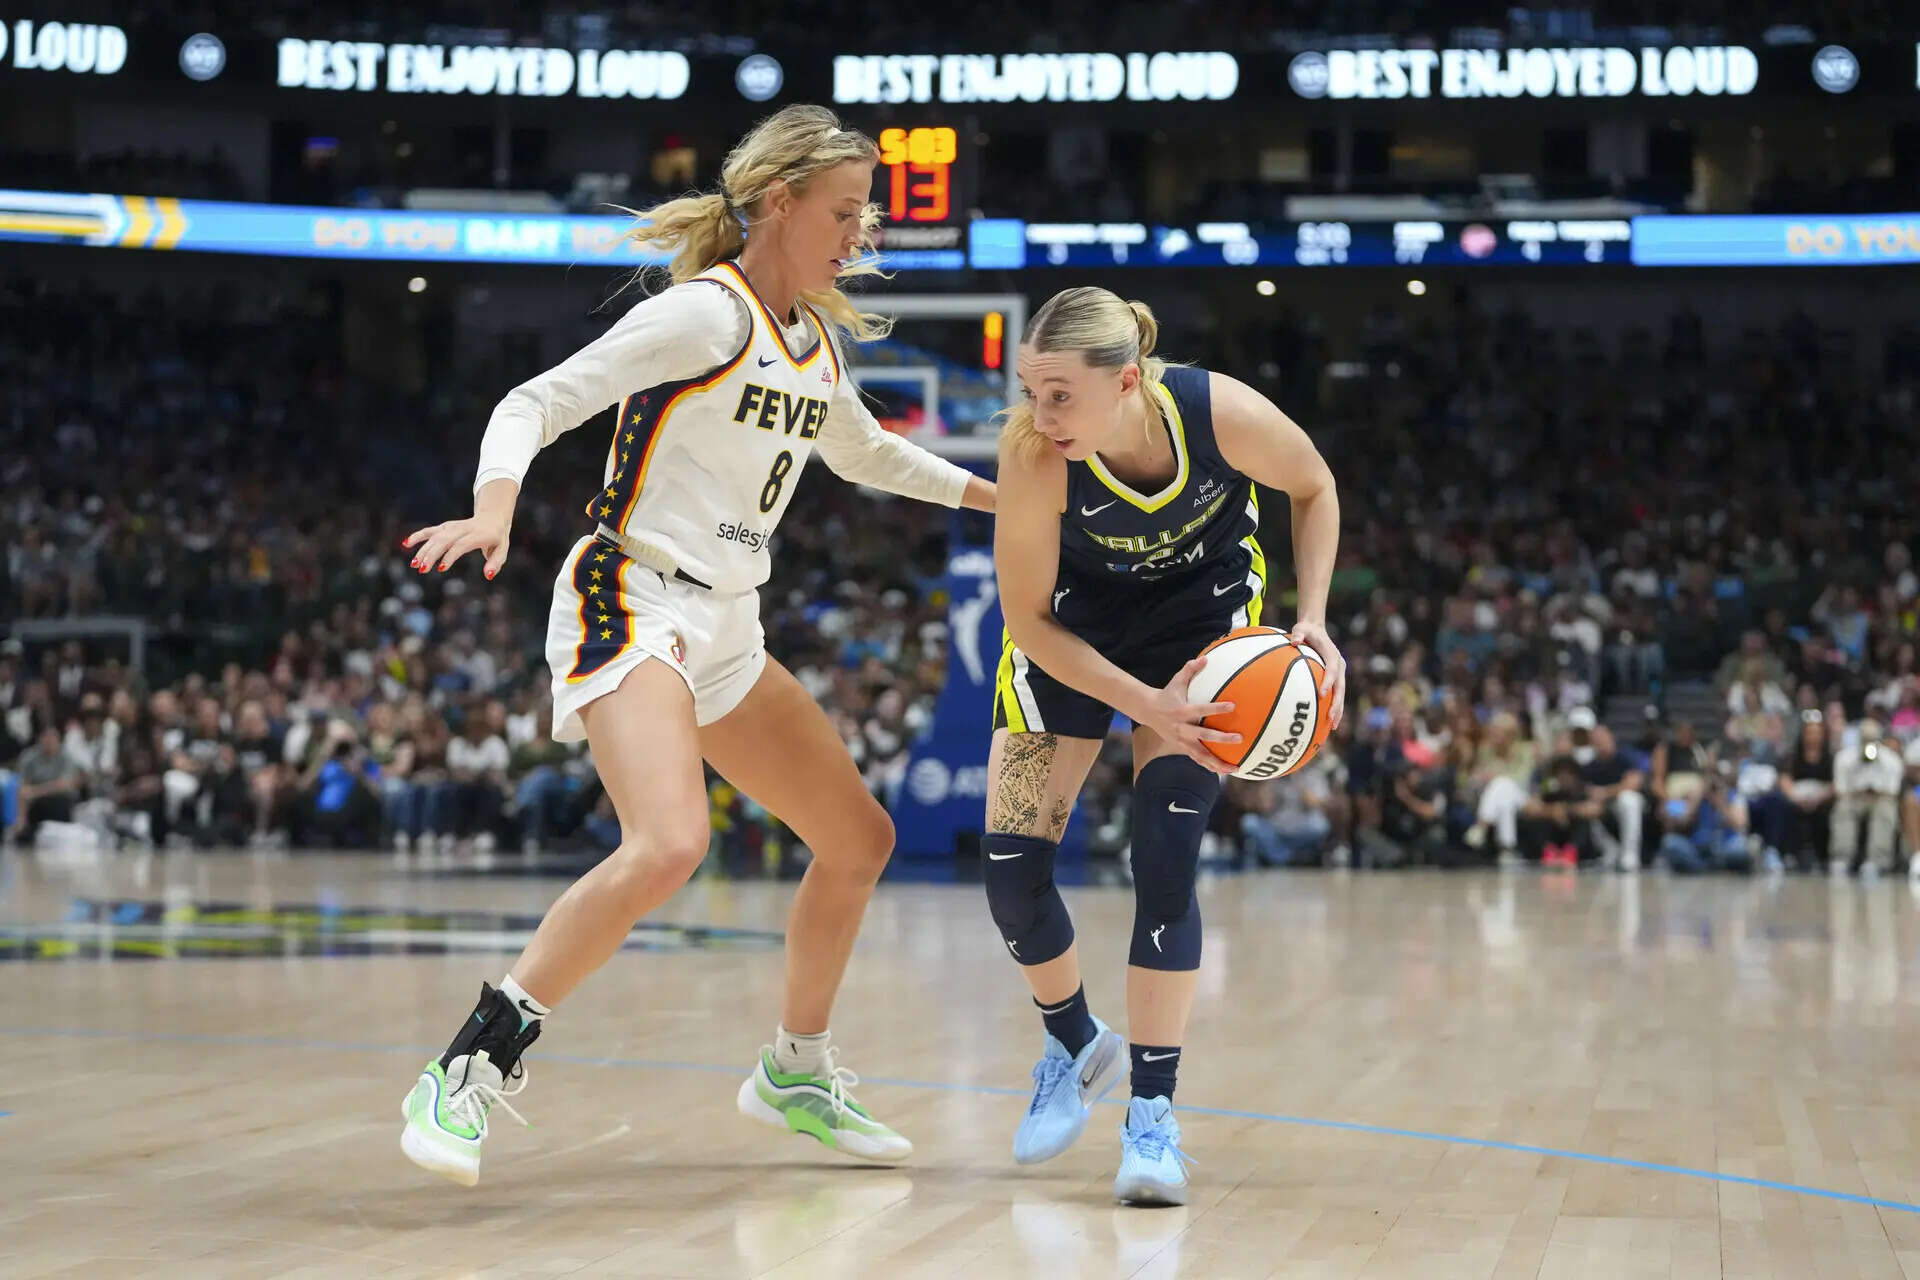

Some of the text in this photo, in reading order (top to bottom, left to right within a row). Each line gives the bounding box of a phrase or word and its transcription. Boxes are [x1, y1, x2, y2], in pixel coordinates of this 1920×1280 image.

[14, 20, 127, 74] LOUD
[278, 38, 385, 91] BEST
[387, 43, 575, 97] ENJOYED
[578, 48, 690, 100] LOUD
[1328, 49, 1438, 99] BEST
[1441, 47, 1637, 98] ENJOYED
[1642, 46, 1759, 96] LOUD
[834, 54, 938, 104] BEST
[940, 53, 1125, 103] ENJOYED
[1127, 51, 1239, 101] LOUD
[890, 162, 949, 221] 13
[313, 216, 372, 248] DO
[380, 218, 458, 252] YOU
[1786, 224, 1846, 257] DO
[759, 449, 794, 514] 8
[1192, 482, 1226, 509] Albert
[1245, 700, 1311, 778] Wilson
